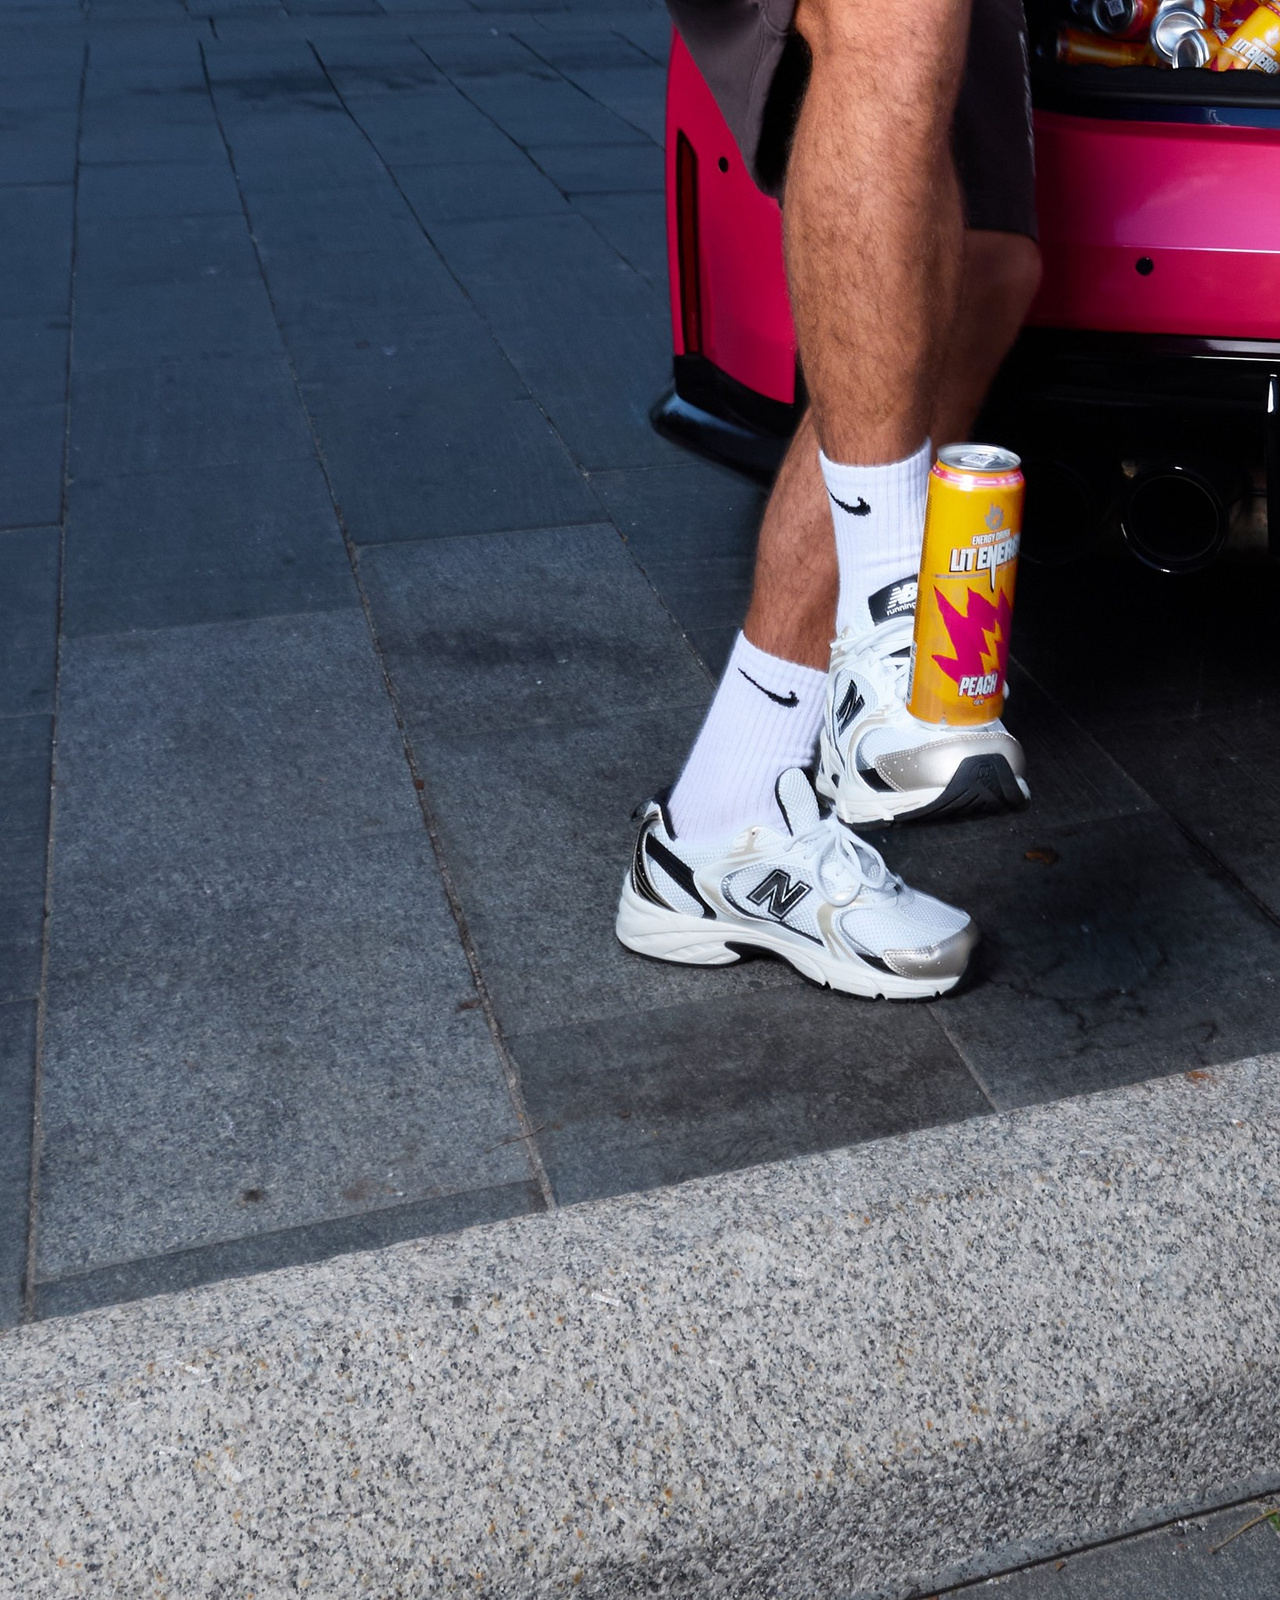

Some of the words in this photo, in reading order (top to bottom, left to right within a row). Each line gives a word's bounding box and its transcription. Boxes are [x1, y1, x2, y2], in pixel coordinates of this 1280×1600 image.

[972, 533, 996, 546] ENERGY
[949, 548, 977, 573] LIT
[975, 533, 1020, 593] ENERG
[958, 673, 998, 697] PEACH
[746, 869, 813, 920] N
